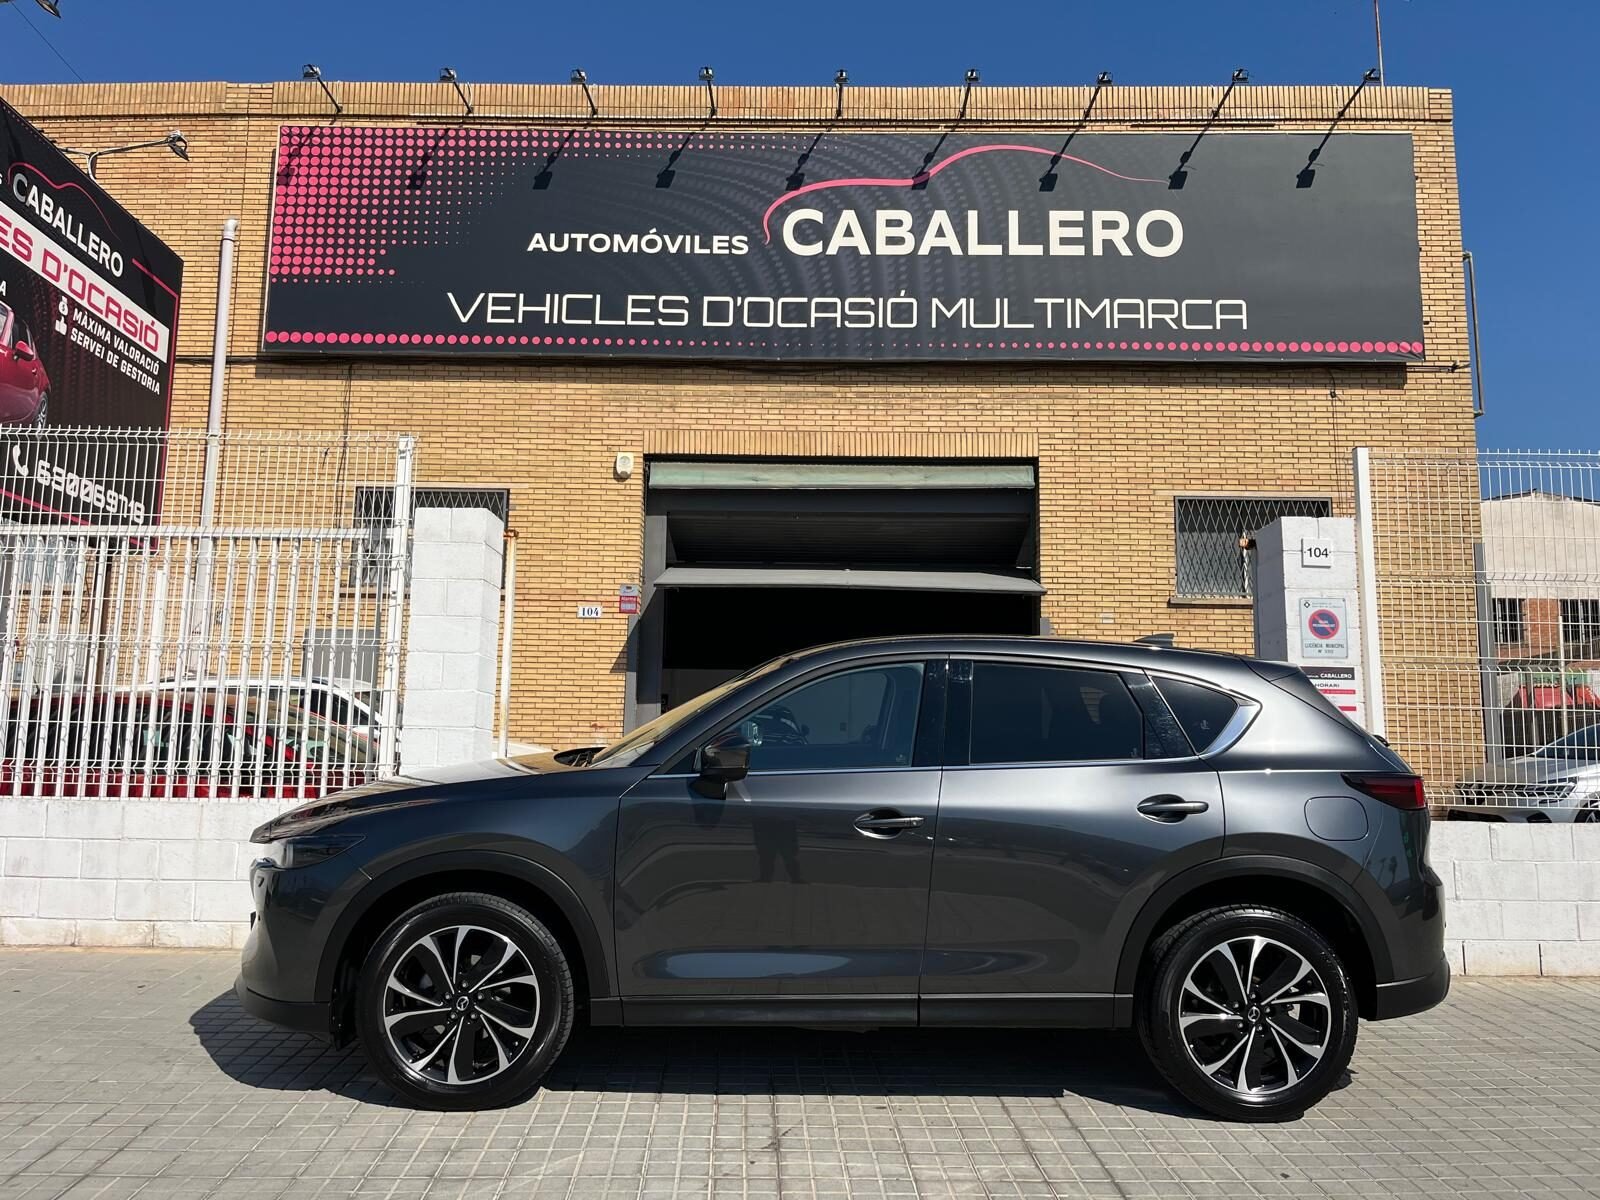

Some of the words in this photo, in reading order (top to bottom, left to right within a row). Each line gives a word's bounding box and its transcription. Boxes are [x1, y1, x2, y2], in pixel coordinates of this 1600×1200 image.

[13, 173, 124, 278] CABALLERO
[526, 228, 749, 255] AUTOMÓVILES
[782, 208, 1184, 257] CABALLERO
[42, 248, 159, 352] D'OCASIÓ
[447, 292, 690, 327] VEHICLES
[702, 290, 918, 328] D'OCASIÓ
[70, 328, 105, 359] SERVEI
[106, 350, 120, 368] DE
[120, 360, 160, 395] GESTORIA
[114, 335, 160, 375] VALORACIÓ
[1306, 547, 1329, 558] 104
[582, 607, 599, 616] 104
